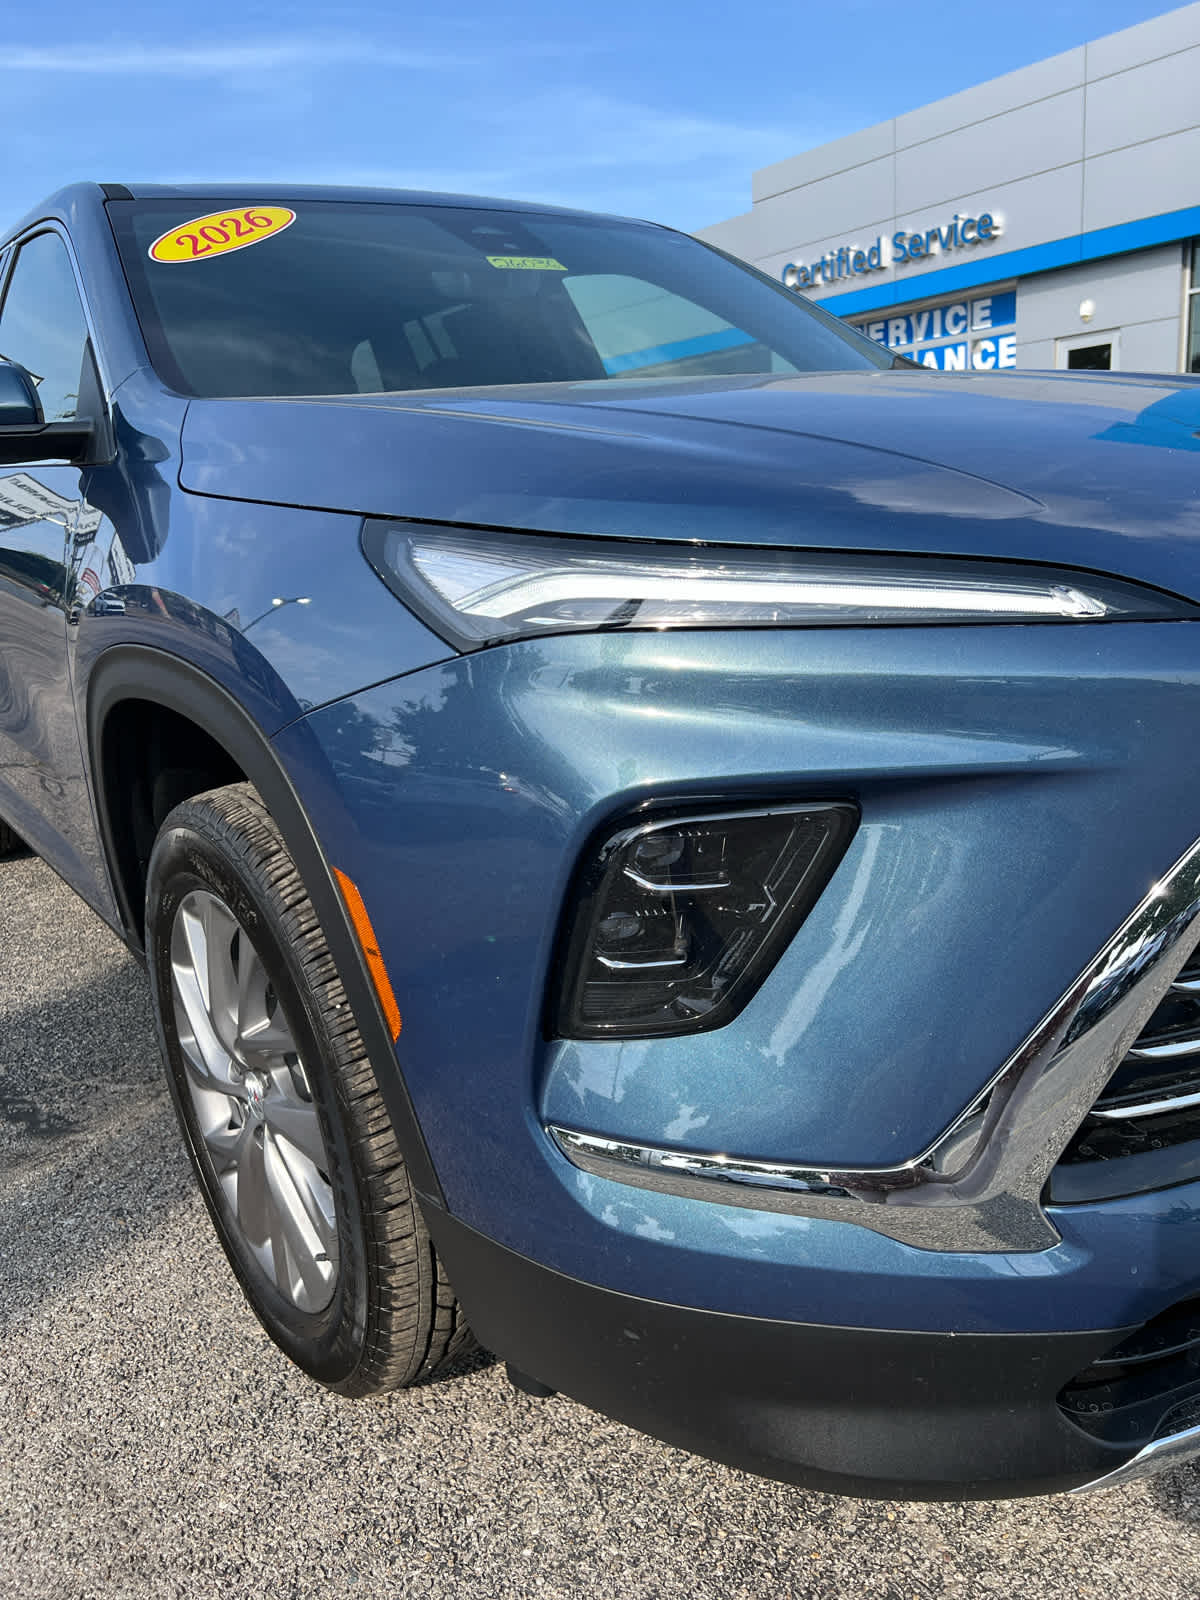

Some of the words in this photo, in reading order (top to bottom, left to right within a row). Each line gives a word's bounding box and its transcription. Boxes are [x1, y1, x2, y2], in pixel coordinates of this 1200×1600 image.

[175, 209, 273, 256] 2026
[781, 236, 882, 288] Certified
[892, 212, 994, 263] Service
[856, 299, 992, 347] ERVICE
